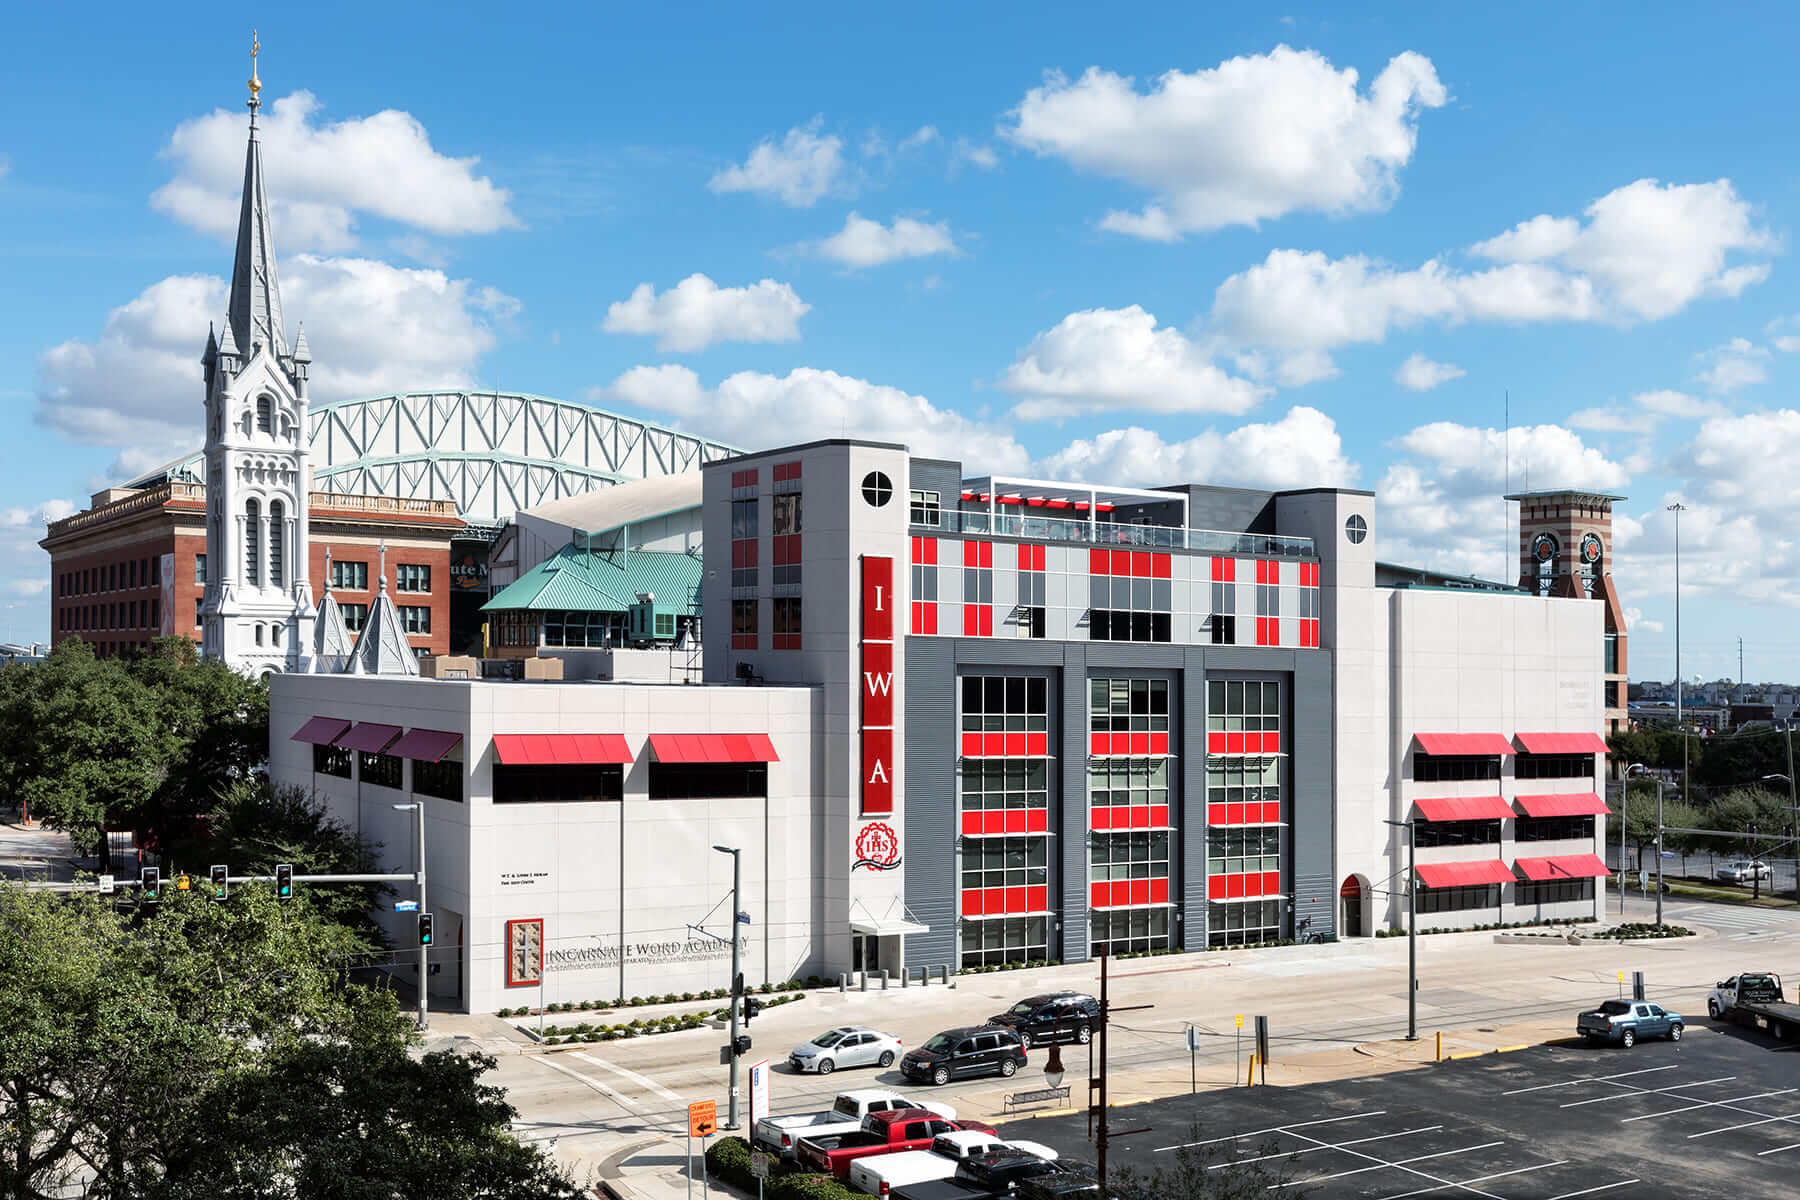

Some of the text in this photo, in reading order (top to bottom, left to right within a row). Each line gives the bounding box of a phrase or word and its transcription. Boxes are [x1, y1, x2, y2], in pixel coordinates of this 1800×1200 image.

[866, 840, 888, 852] IHS
[636, 942, 680, 955] WORD
[685, 936, 750, 952] ACADEY
